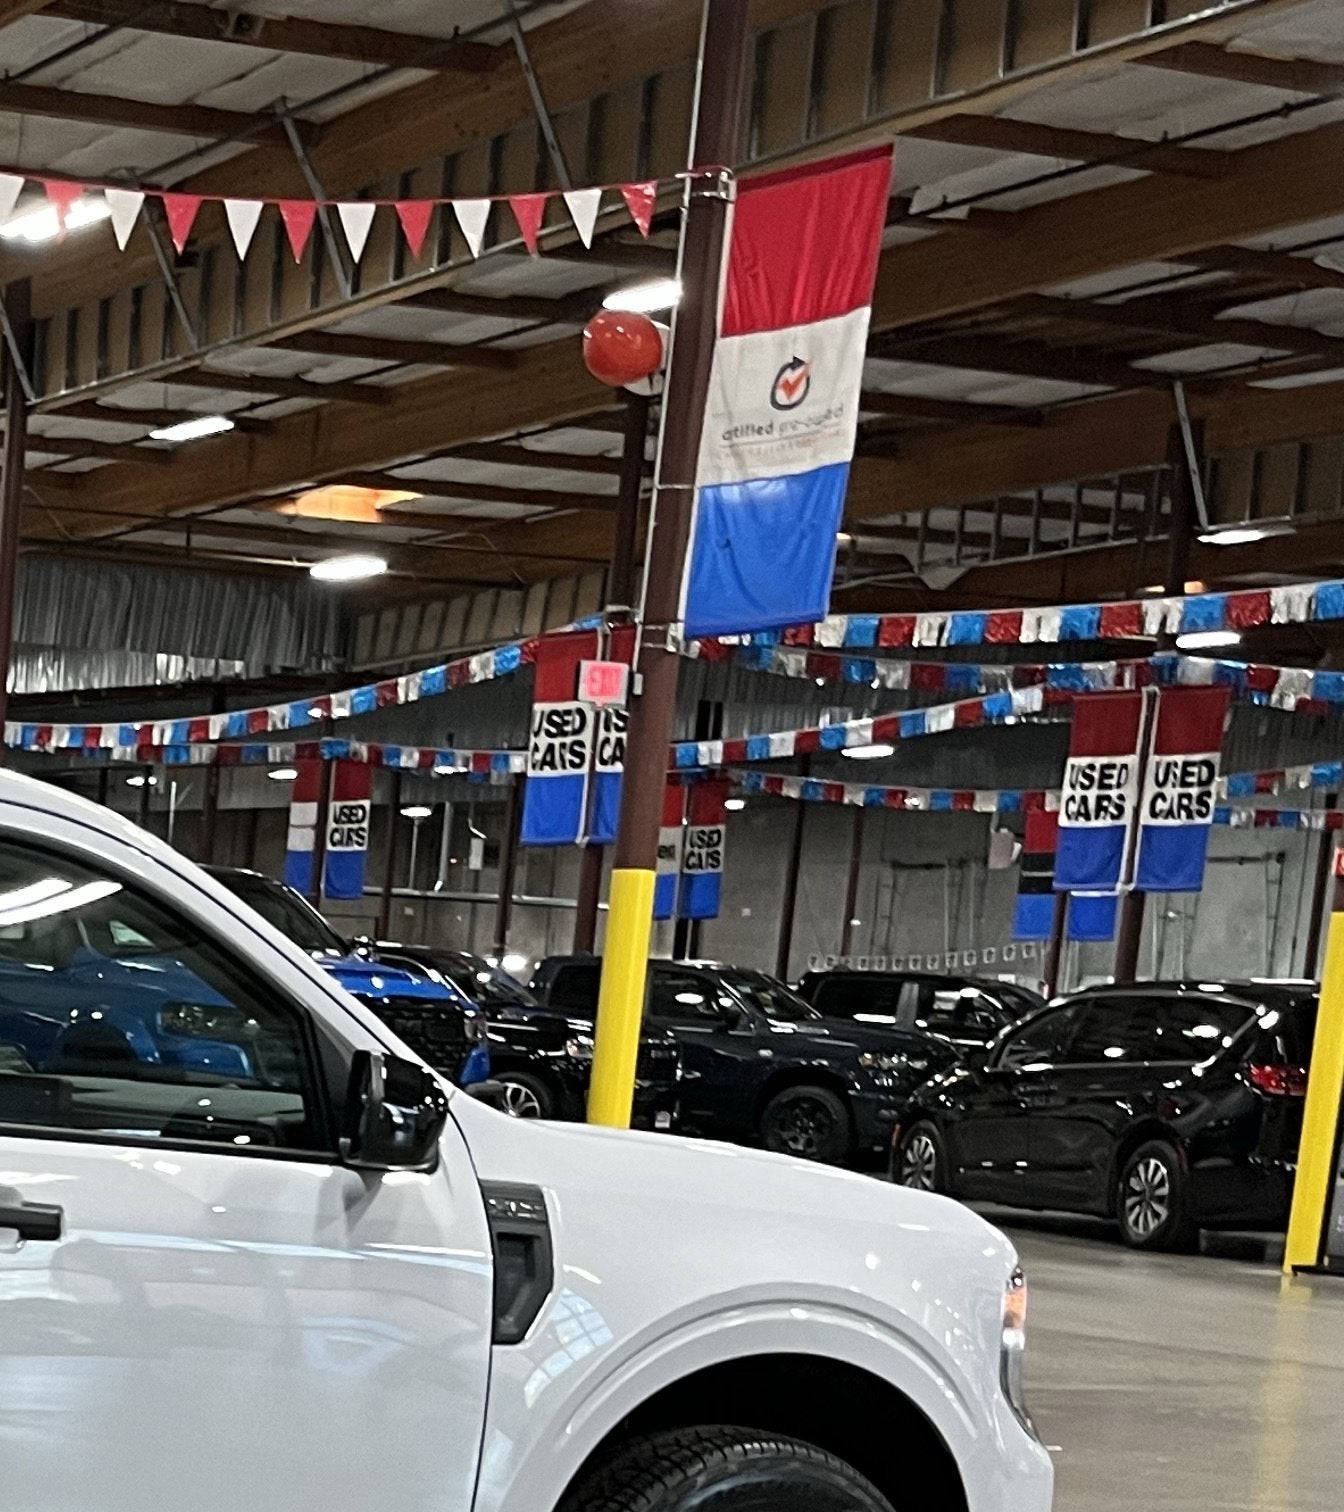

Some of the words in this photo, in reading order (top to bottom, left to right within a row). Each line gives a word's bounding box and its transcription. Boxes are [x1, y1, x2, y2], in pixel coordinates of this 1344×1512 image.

[533, 707, 587, 738] USED
[598, 736, 627, 766] CA
[1069, 763, 1130, 791] USED
[1154, 760, 1216, 789] USED
[332, 804, 367, 825] USED
[1064, 794, 1126, 821] CARS
[1149, 791, 1212, 821] CARS
